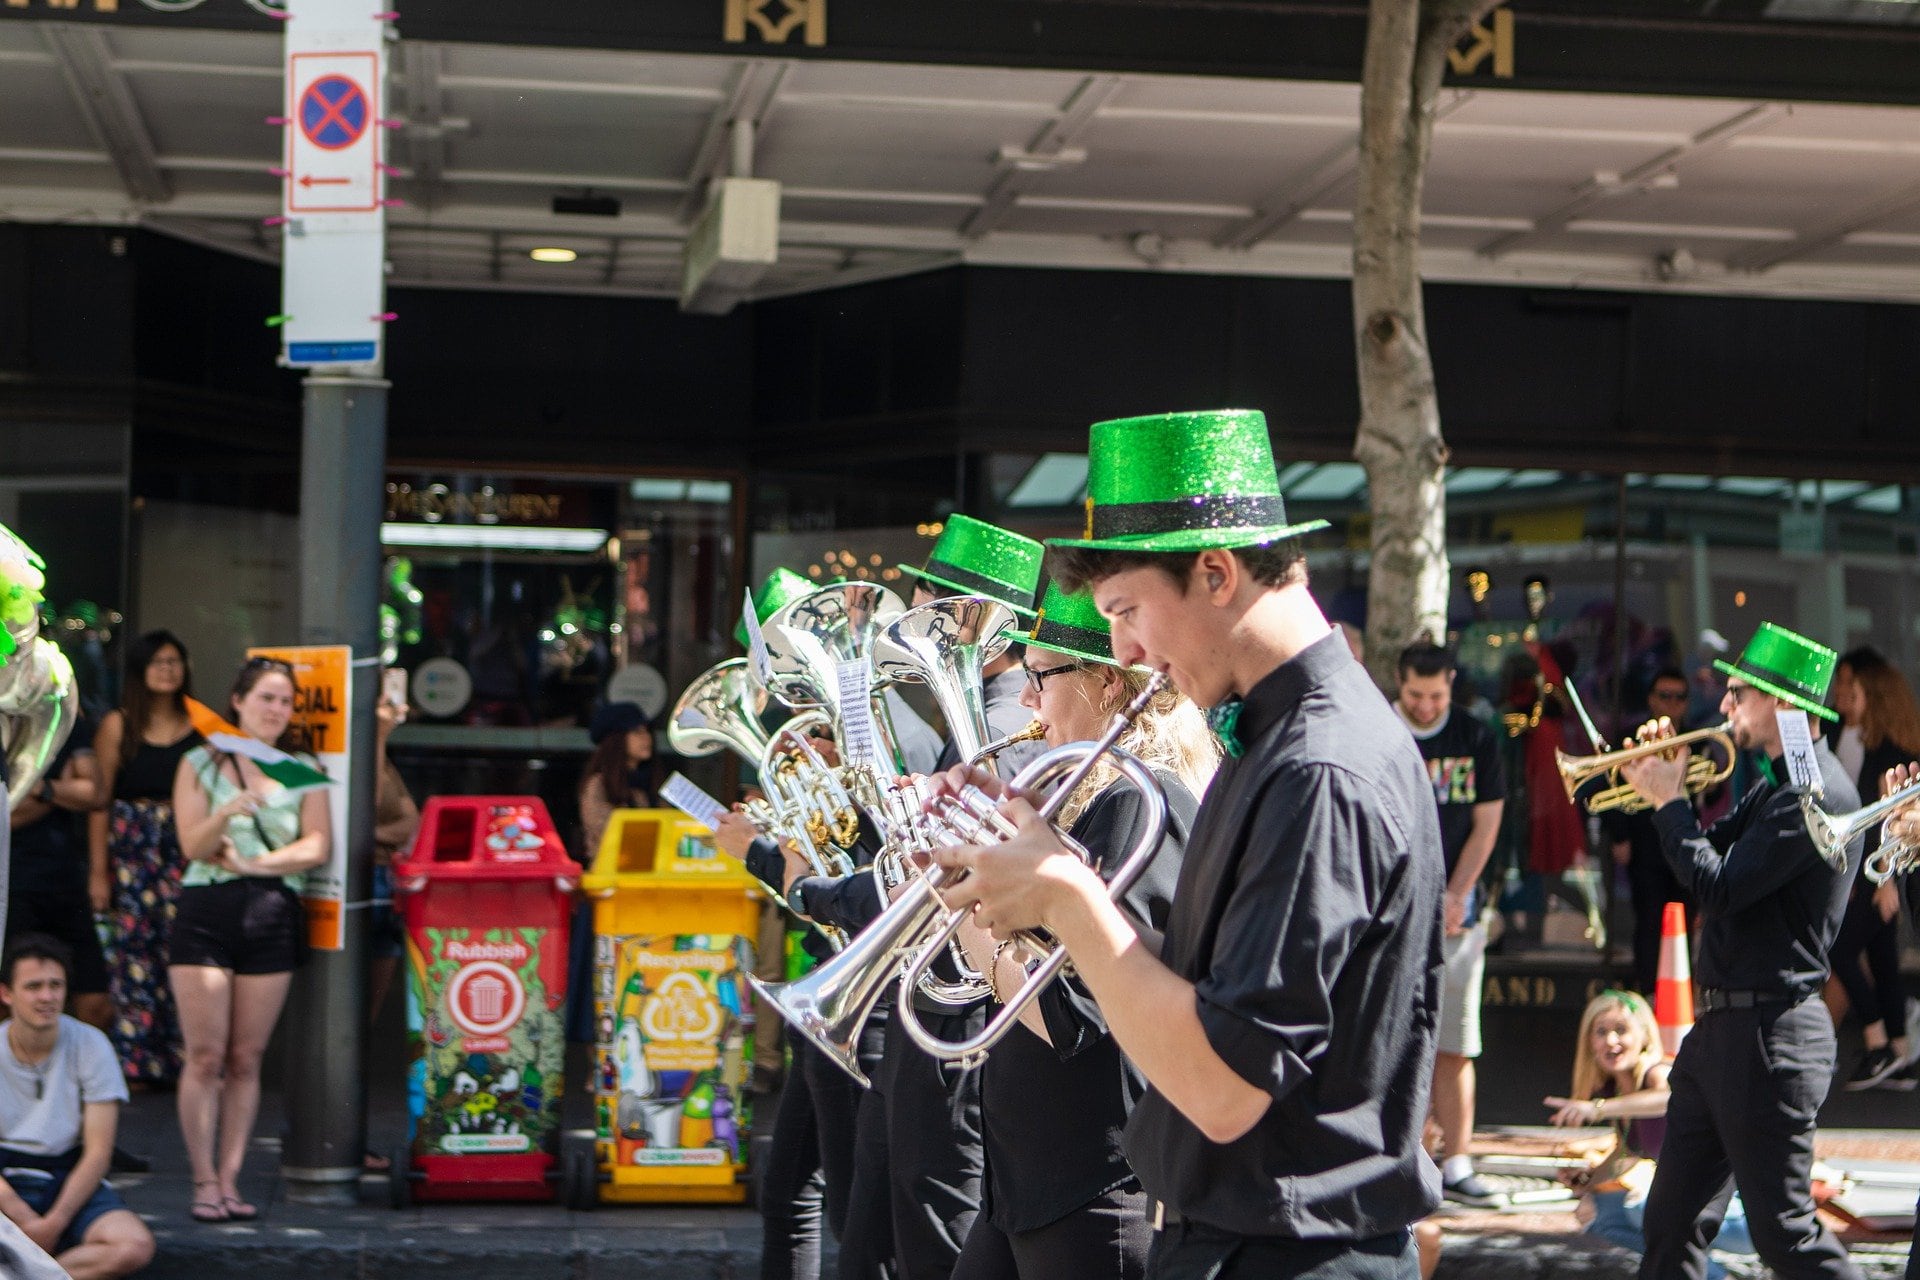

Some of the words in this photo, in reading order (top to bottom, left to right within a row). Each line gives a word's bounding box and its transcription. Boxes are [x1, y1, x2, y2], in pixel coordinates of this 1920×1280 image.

[293, 685, 338, 713] CIAL
[447, 941, 528, 960] Rubbish
[637, 951, 727, 972] Recycling
